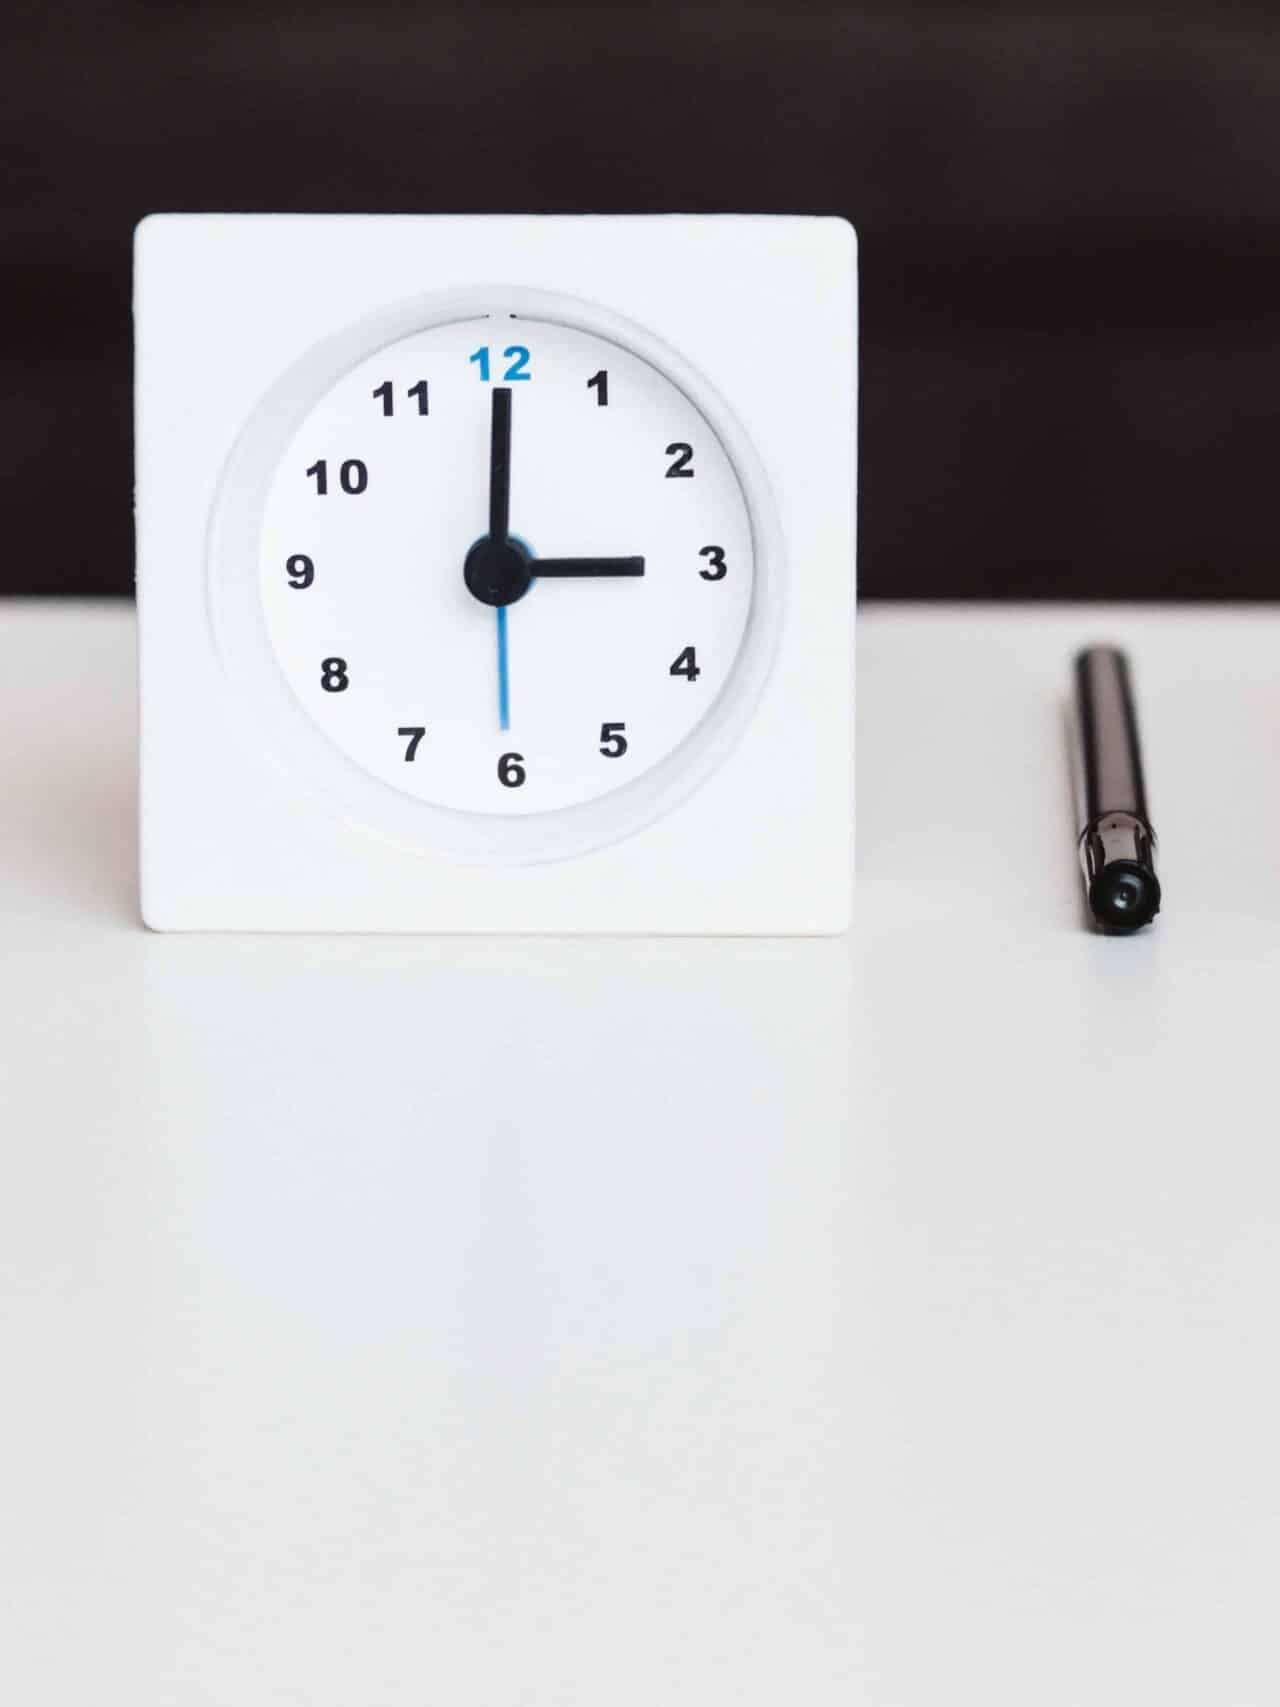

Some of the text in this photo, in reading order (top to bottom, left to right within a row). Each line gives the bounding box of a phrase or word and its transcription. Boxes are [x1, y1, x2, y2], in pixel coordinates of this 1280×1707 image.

[469, 345, 531, 382] 12
[373, 380, 430, 417] 11
[587, 370, 609, 407] 1
[306, 458, 369, 496] 10
[665, 442, 695, 479] 2
[286, 554, 315, 590] 9
[698, 545, 728, 582] 3
[320, 657, 349, 693] 8
[669, 646, 701, 682] 4
[397, 727, 426, 762] 7
[599, 722, 628, 758] 5
[497, 752, 526, 788] 6
